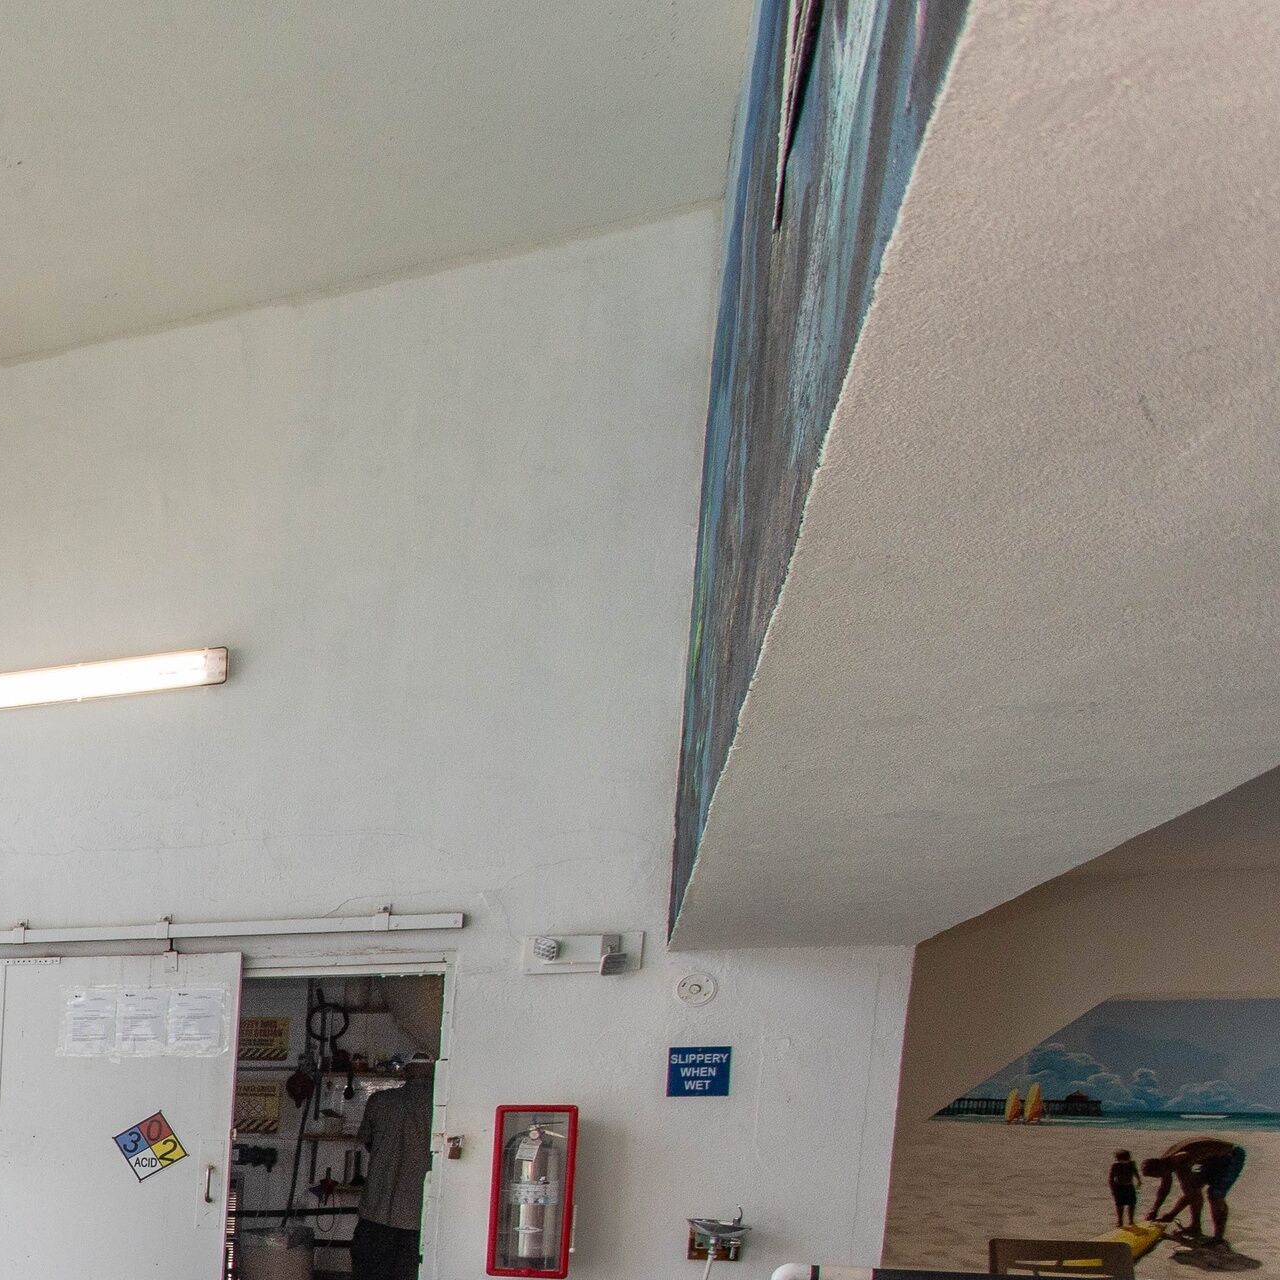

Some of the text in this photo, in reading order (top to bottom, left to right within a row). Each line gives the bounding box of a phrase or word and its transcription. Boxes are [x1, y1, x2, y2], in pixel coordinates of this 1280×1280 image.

[670, 1053, 729, 1064] SLIPPERY
[680, 1067, 716, 1077] WHEN
[684, 1080, 712, 1090] WET
[123, 1131, 141, 1153] 3
[158, 1138, 177, 1162] 2
[134, 1157, 158, 1168] ACID
